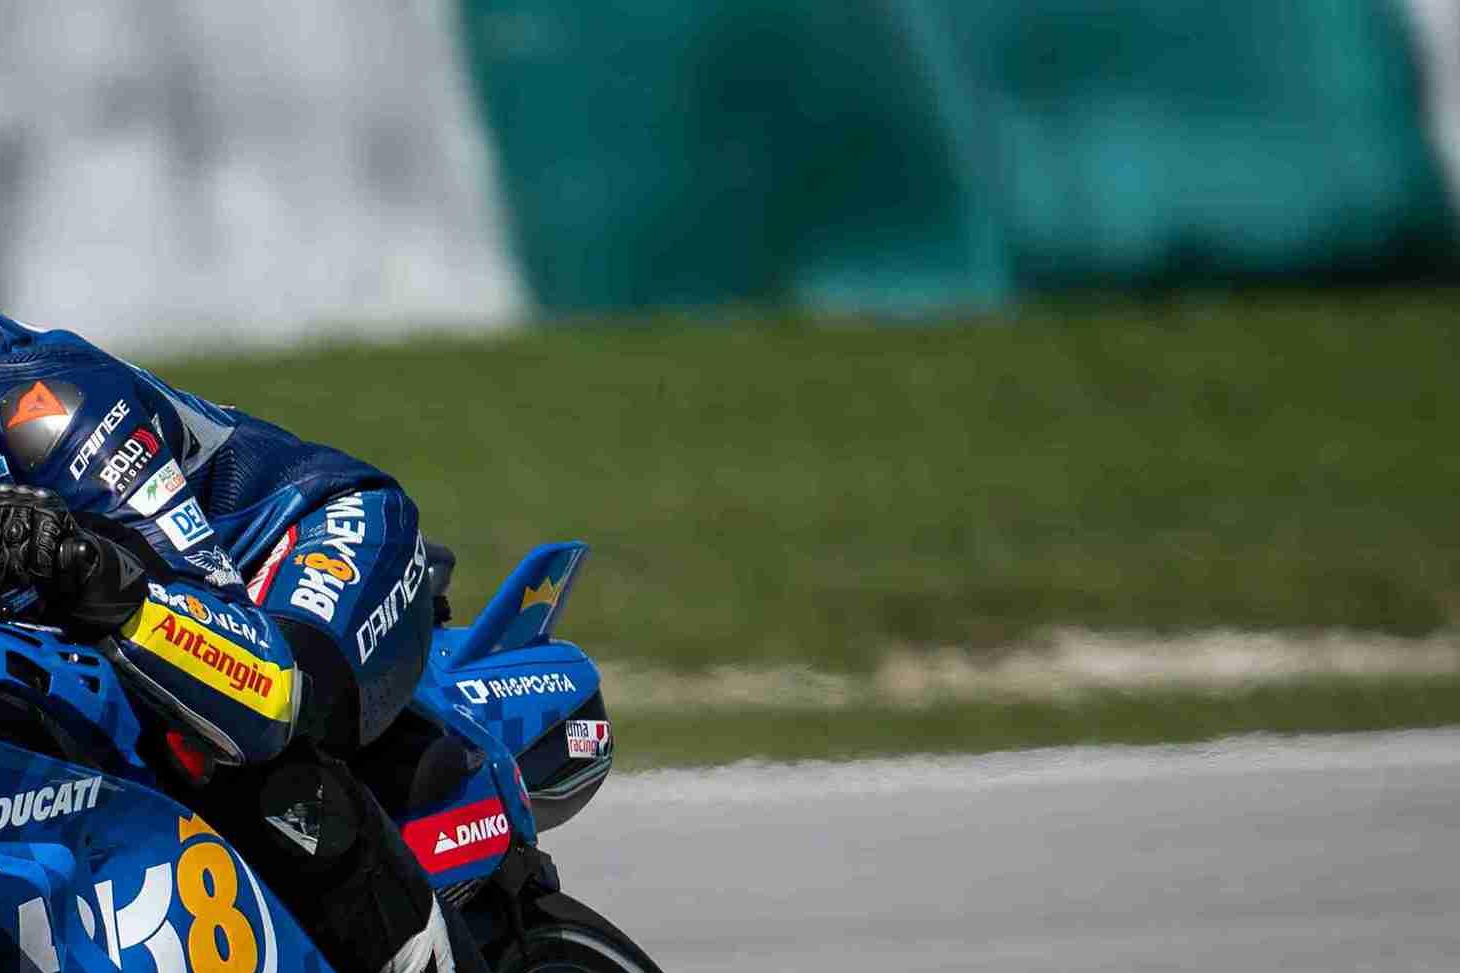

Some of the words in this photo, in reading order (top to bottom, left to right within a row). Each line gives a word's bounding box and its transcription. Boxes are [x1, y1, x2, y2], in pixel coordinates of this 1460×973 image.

[70, 400, 131, 480] DAINESE
[100, 438, 144, 488] BOLD
[151, 613, 274, 698] Antangin
[488, 672, 577, 700] RISPOSTA
